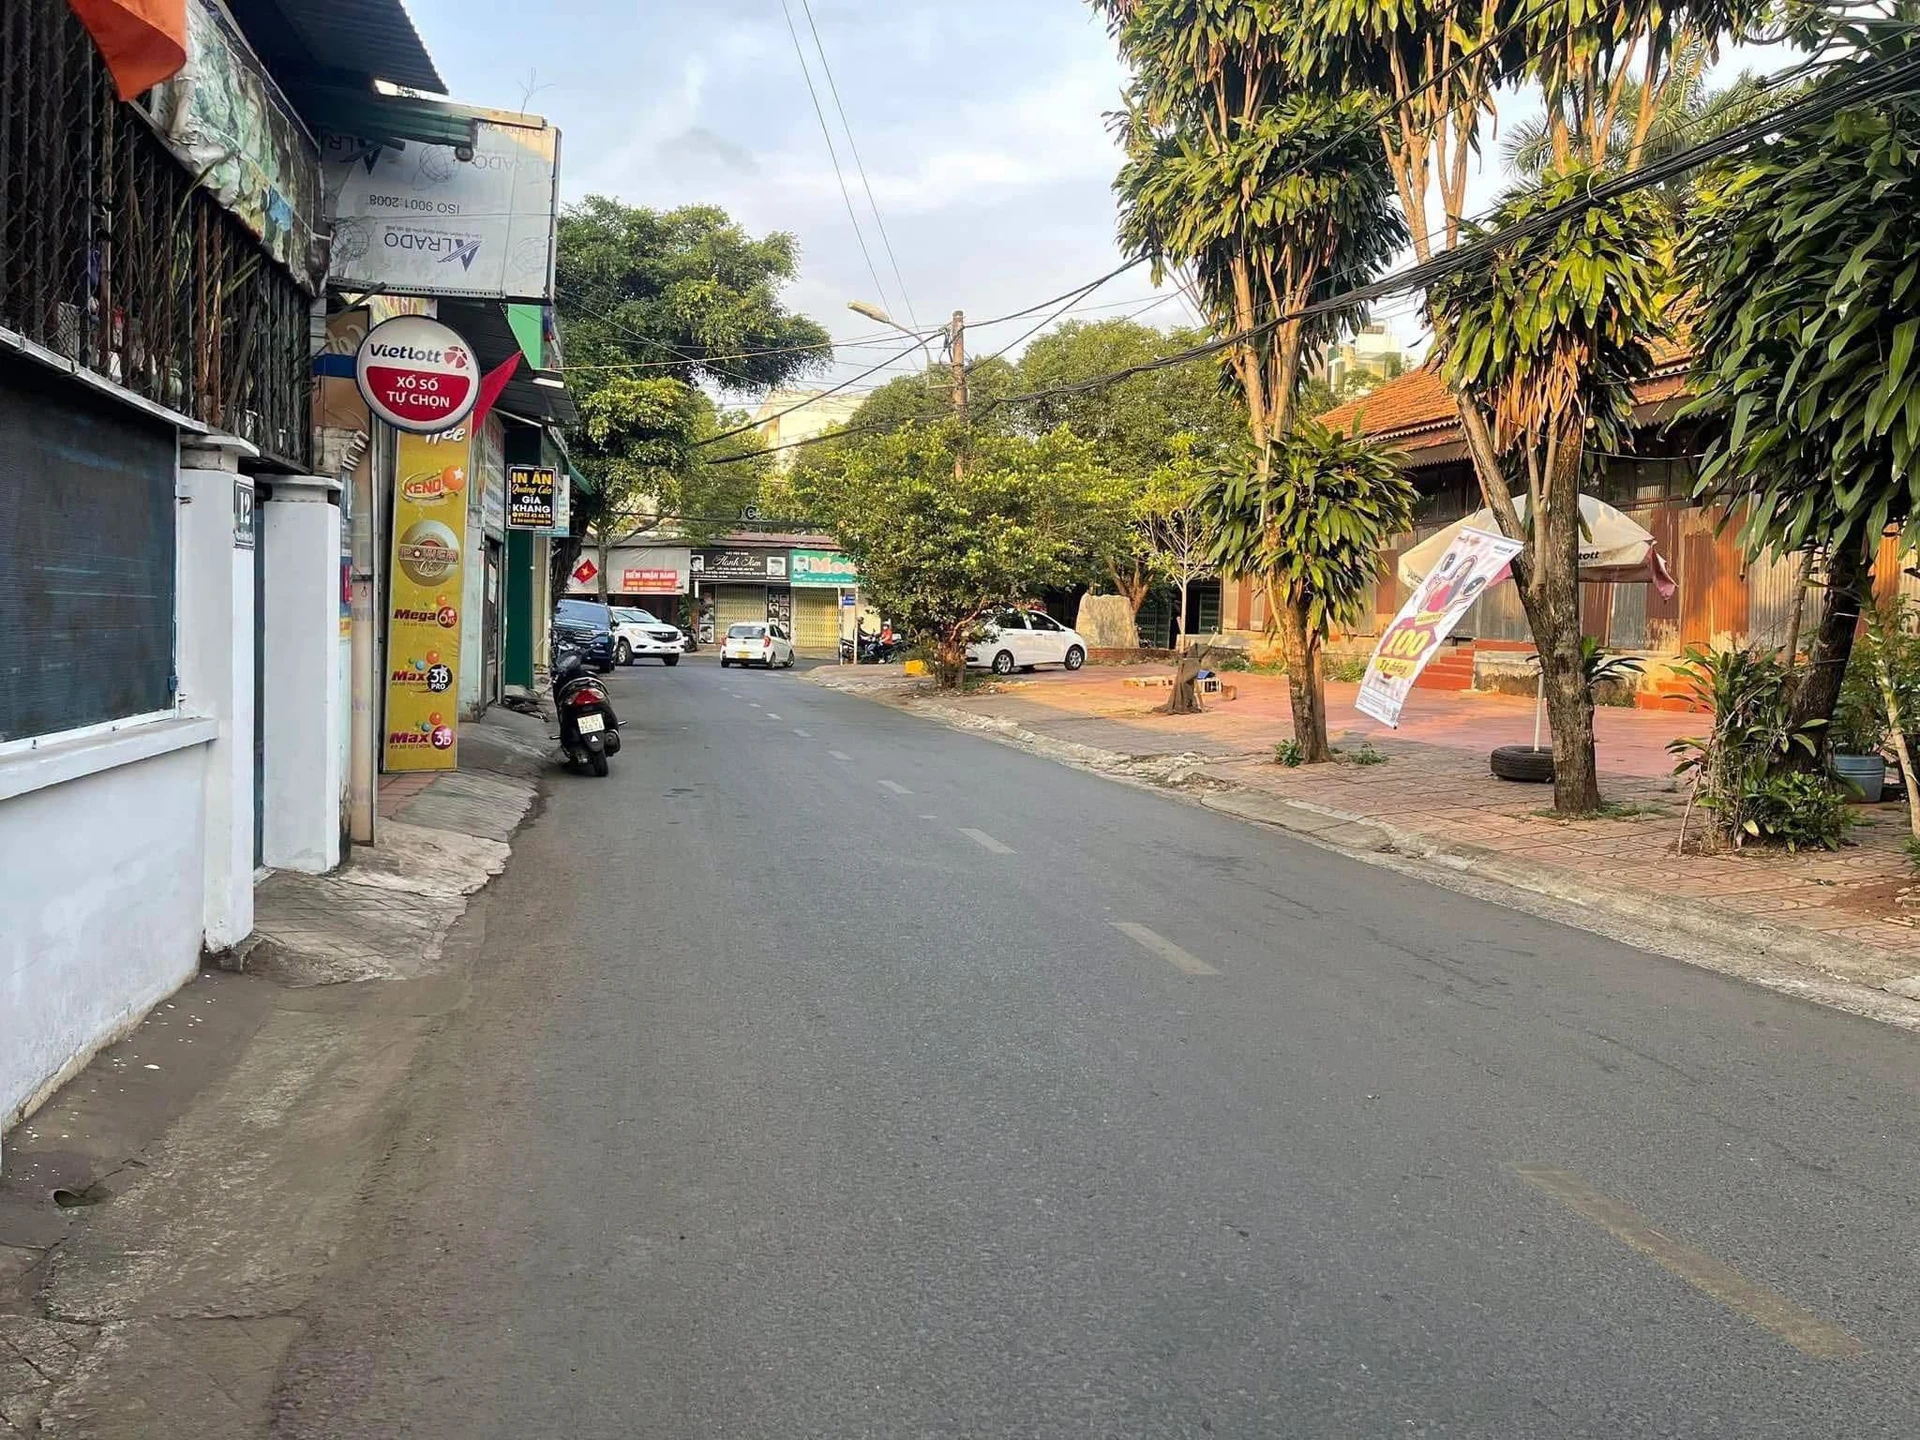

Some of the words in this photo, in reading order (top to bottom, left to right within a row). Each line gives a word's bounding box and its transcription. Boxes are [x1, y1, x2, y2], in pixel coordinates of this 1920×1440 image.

[436, 202, 460, 214] ISO
[384, 232, 482, 273] ALRADO
[369, 343, 442, 364] Vietlott
[386, 390, 407, 406] TỰ
[409, 393, 451, 409] CHỌN
[512, 472, 528, 483] IN
[521, 496, 542, 504] GIA
[240, 492, 251, 525] 12
[511, 504, 551, 514] KHANG
[394, 608, 436, 622] Mega
[1382, 629, 1432, 658] 100
[391, 670, 426, 682] Max
[390, 731, 430, 744] Max
[434, 731, 452, 746] 3D
